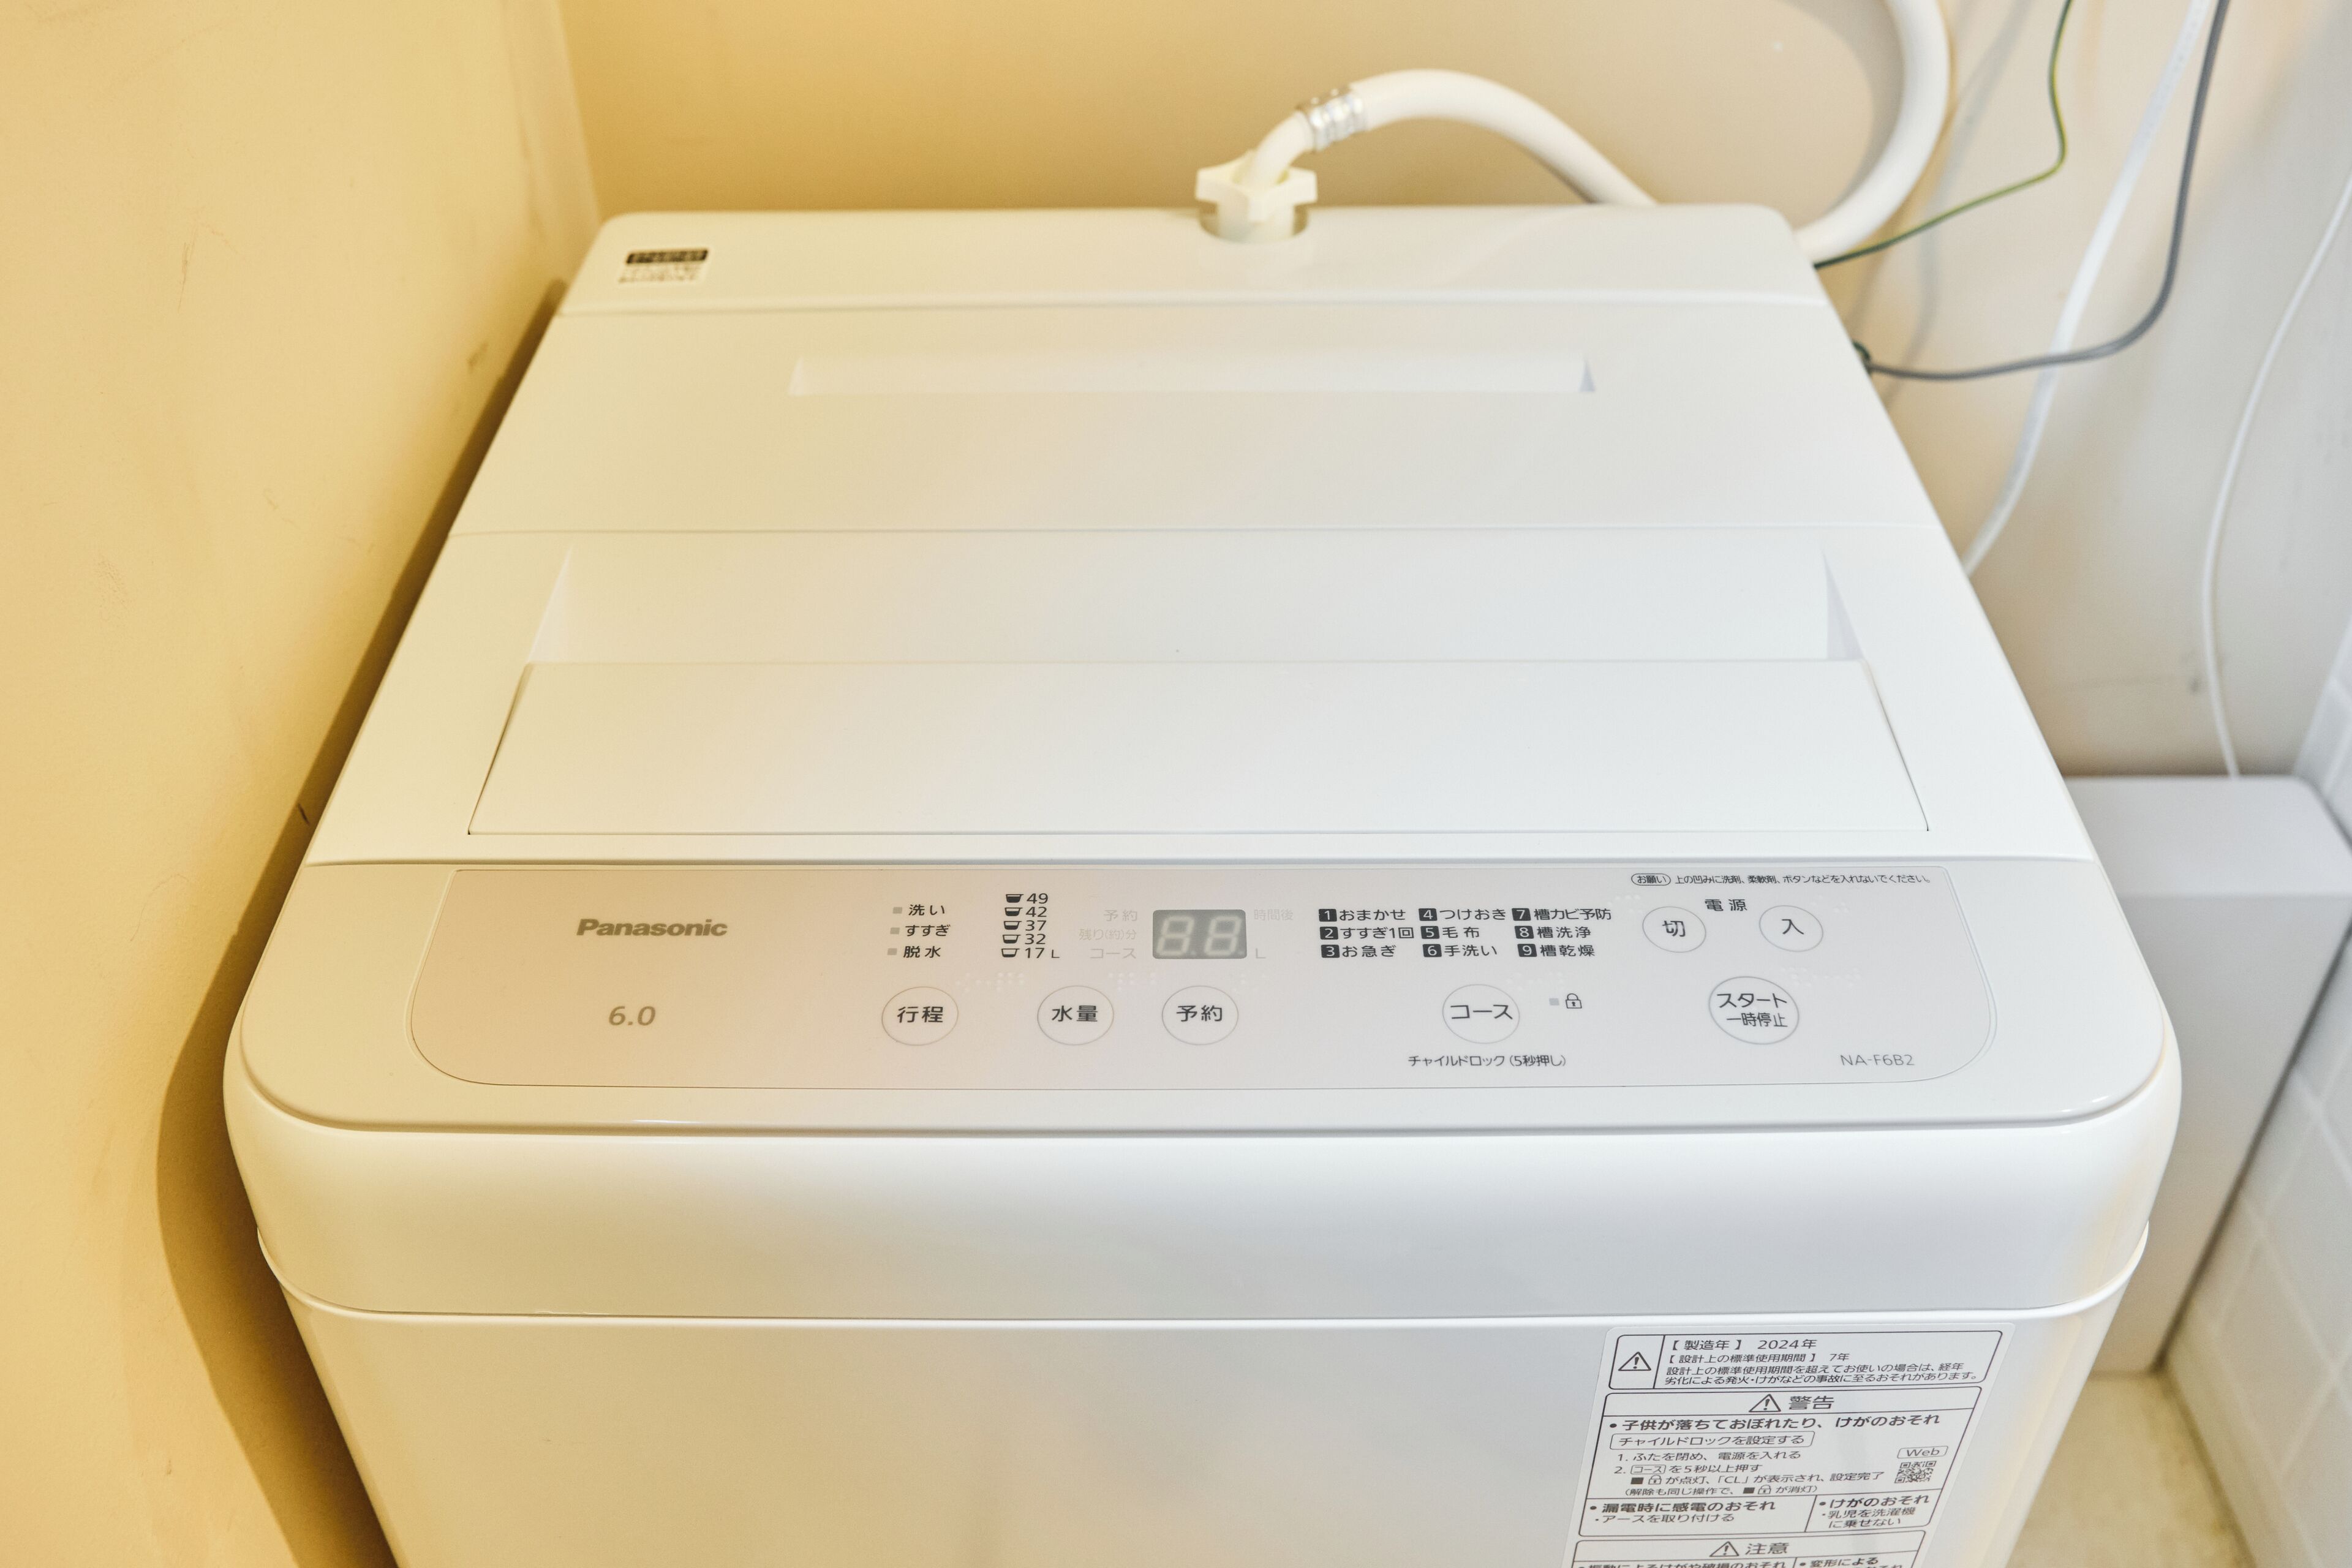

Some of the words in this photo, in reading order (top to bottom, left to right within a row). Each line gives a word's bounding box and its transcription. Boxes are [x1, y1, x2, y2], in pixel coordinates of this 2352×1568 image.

[1636, 875, 1667, 884] お願い
[1026, 892, 1049, 905] 49
[1705, 899, 1747, 911] 電源
[908, 903, 946, 916] 洗い
[1025, 907, 1047, 918] 42
[1104, 909, 1138, 922] 予約
[1254, 909, 1294, 922] 時間後
[1339, 909, 1406, 921] おまかせ
[1439, 908, 1507, 920] つけおき
[1534, 908, 1612, 921] 槽カビ予防
[576, 918, 728, 937] Panasonic
[905, 924, 951, 937] すすぎ
[1025, 920, 1047, 932] 37
[1442, 926, 1480, 938] 毛布
[1537, 925, 1592, 939] 槽洗浄
[1662, 920, 1686, 937] 切
[1781, 918, 1804, 935] 入
[1024, 933, 1046, 944] 32
[1340, 927, 1414, 939] すすぎ1回
[903, 945, 941, 959] 脱水
[1024, 948, 1045, 959] 17
[1051, 949, 1060, 959] L
[1090, 948, 1137, 959] コース
[1256, 949, 1267, 959] L
[1341, 944, 1397, 957] お急ぎ
[1444, 944, 1498, 957] 手洗い
[1540, 944, 1595, 957] 槽乾燥
[1717, 992, 1787, 1008] スタート
[608, 1005, 656, 1026] 6.0
[897, 1006, 944, 1023] 行程
[1051, 1005, 1098, 1022] 水量
[1176, 1005, 1223, 1022] 予約
[1450, 1003, 1513, 1020] コース
[1726, 1012, 1788, 1028] 一時停止
[1840, 1054, 1915, 1066] NA-F6B2
[1672, 1339, 1742, 1351] 【製造年】
[1757, 1339, 1817, 1349] 2024年
[1830, 1352, 1850, 1362] 7年
[1666, 1362, 1964, 1376] 設計上の標準使用期間を超えてお使いの場合は、経年
[1789, 1395, 1834, 1410] 警告
[1618, 1435, 1804, 1446] チャイルドロックを設定する
[1905, 1447, 1940, 1457] Web
[1613, 1466, 1626, 1474] 2.
[1602, 1501, 1776, 1513] 漏電時に感電のおそれ
[1830, 1494, 1929, 1509] けがのおそれ
[1602, 1513, 1735, 1523] アースを取り付ける
[1828, 1506, 1916, 1519] 乳児を洗濯機
[1828, 1518, 1901, 1529] に乗せない
[1744, 1542, 1790, 1555] 注意
[1809, 1556, 1879, 1568] 変形による
